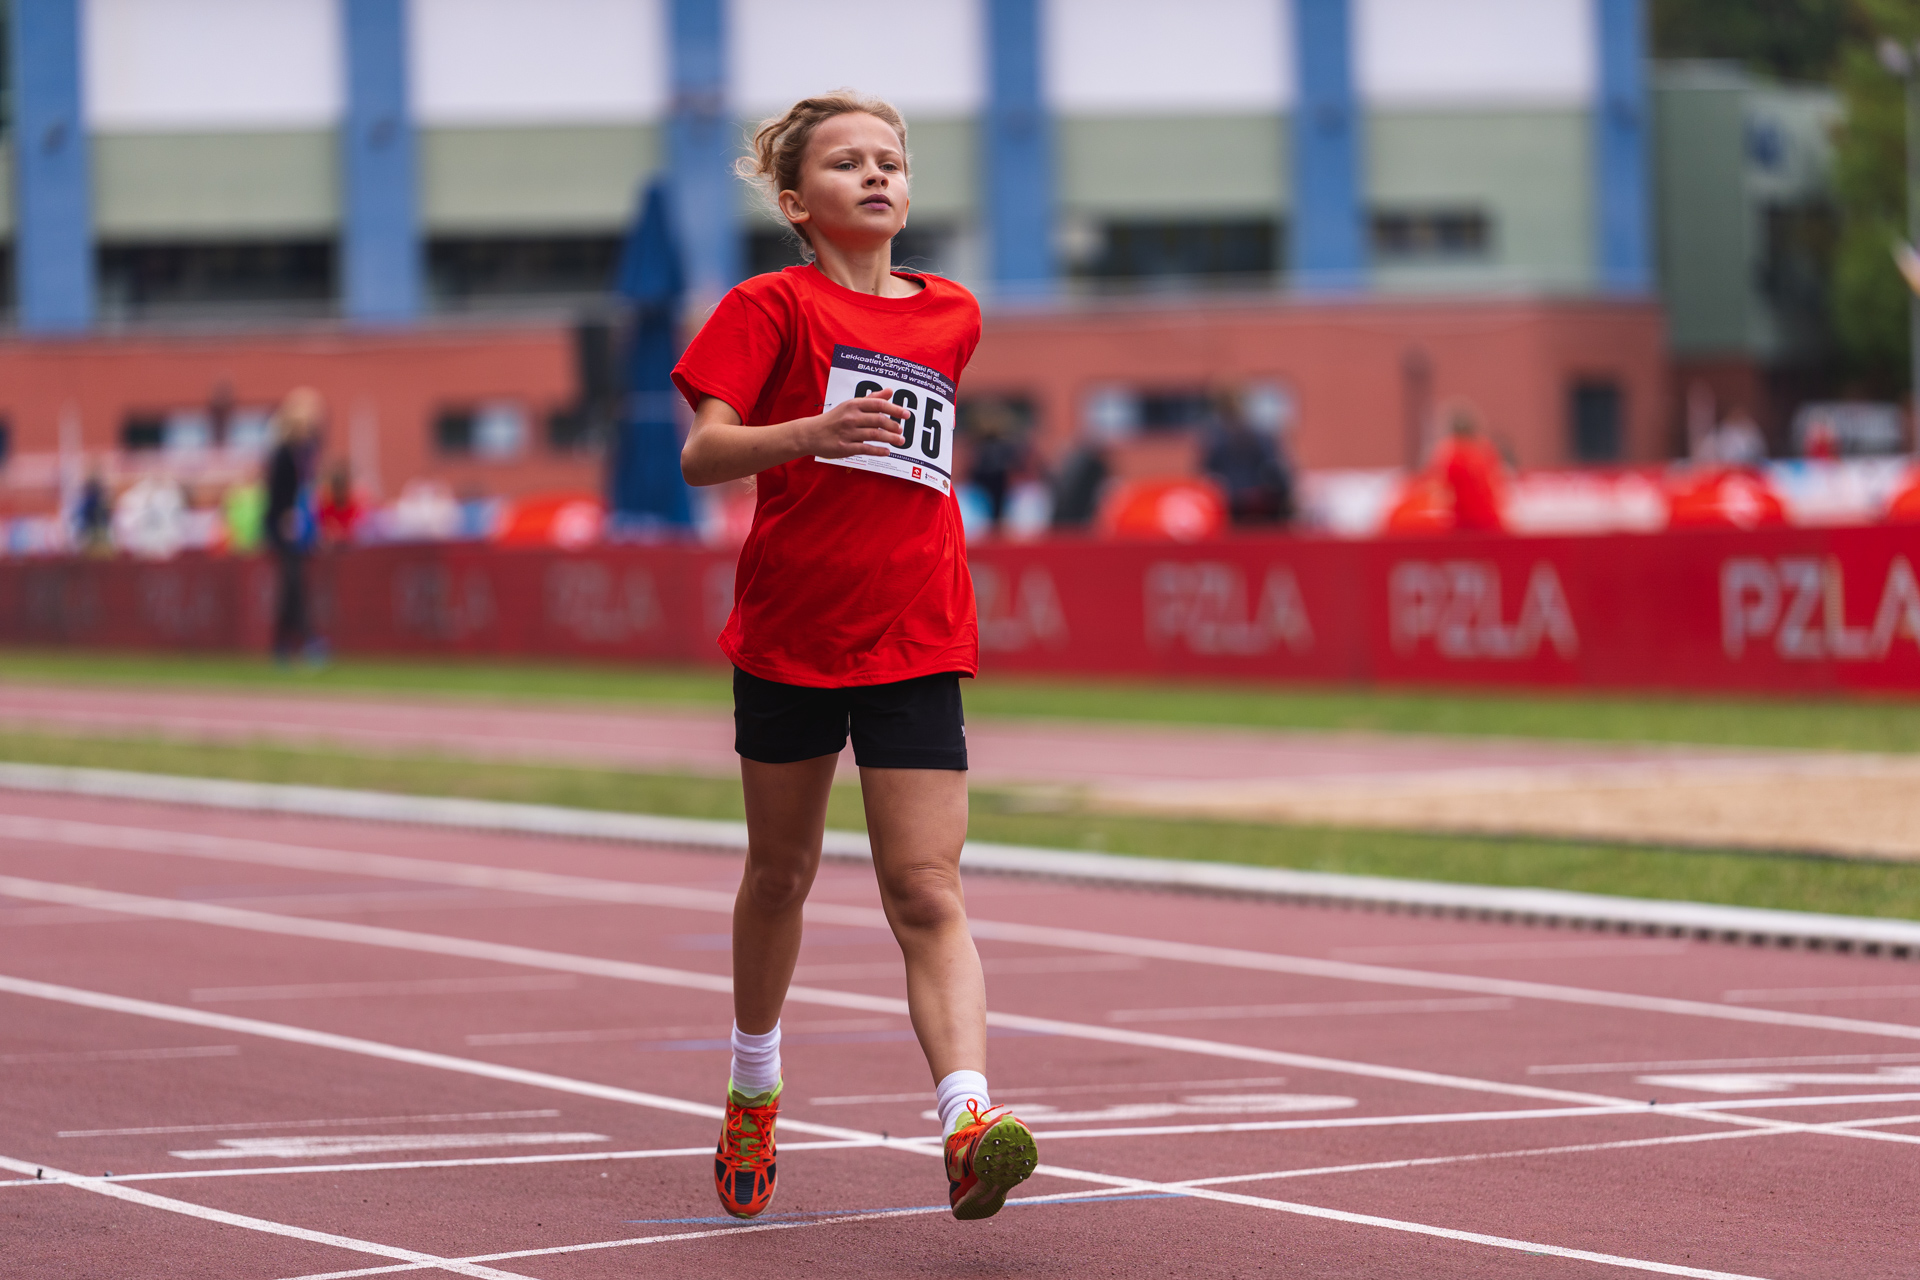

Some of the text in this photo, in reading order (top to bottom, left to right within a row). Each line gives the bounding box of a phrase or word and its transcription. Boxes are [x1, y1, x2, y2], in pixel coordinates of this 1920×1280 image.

[840, 352, 911, 373] Lekkoatletycznych
[1386, 559, 1580, 658] PZLA
[1719, 554, 1920, 660] PZLA
